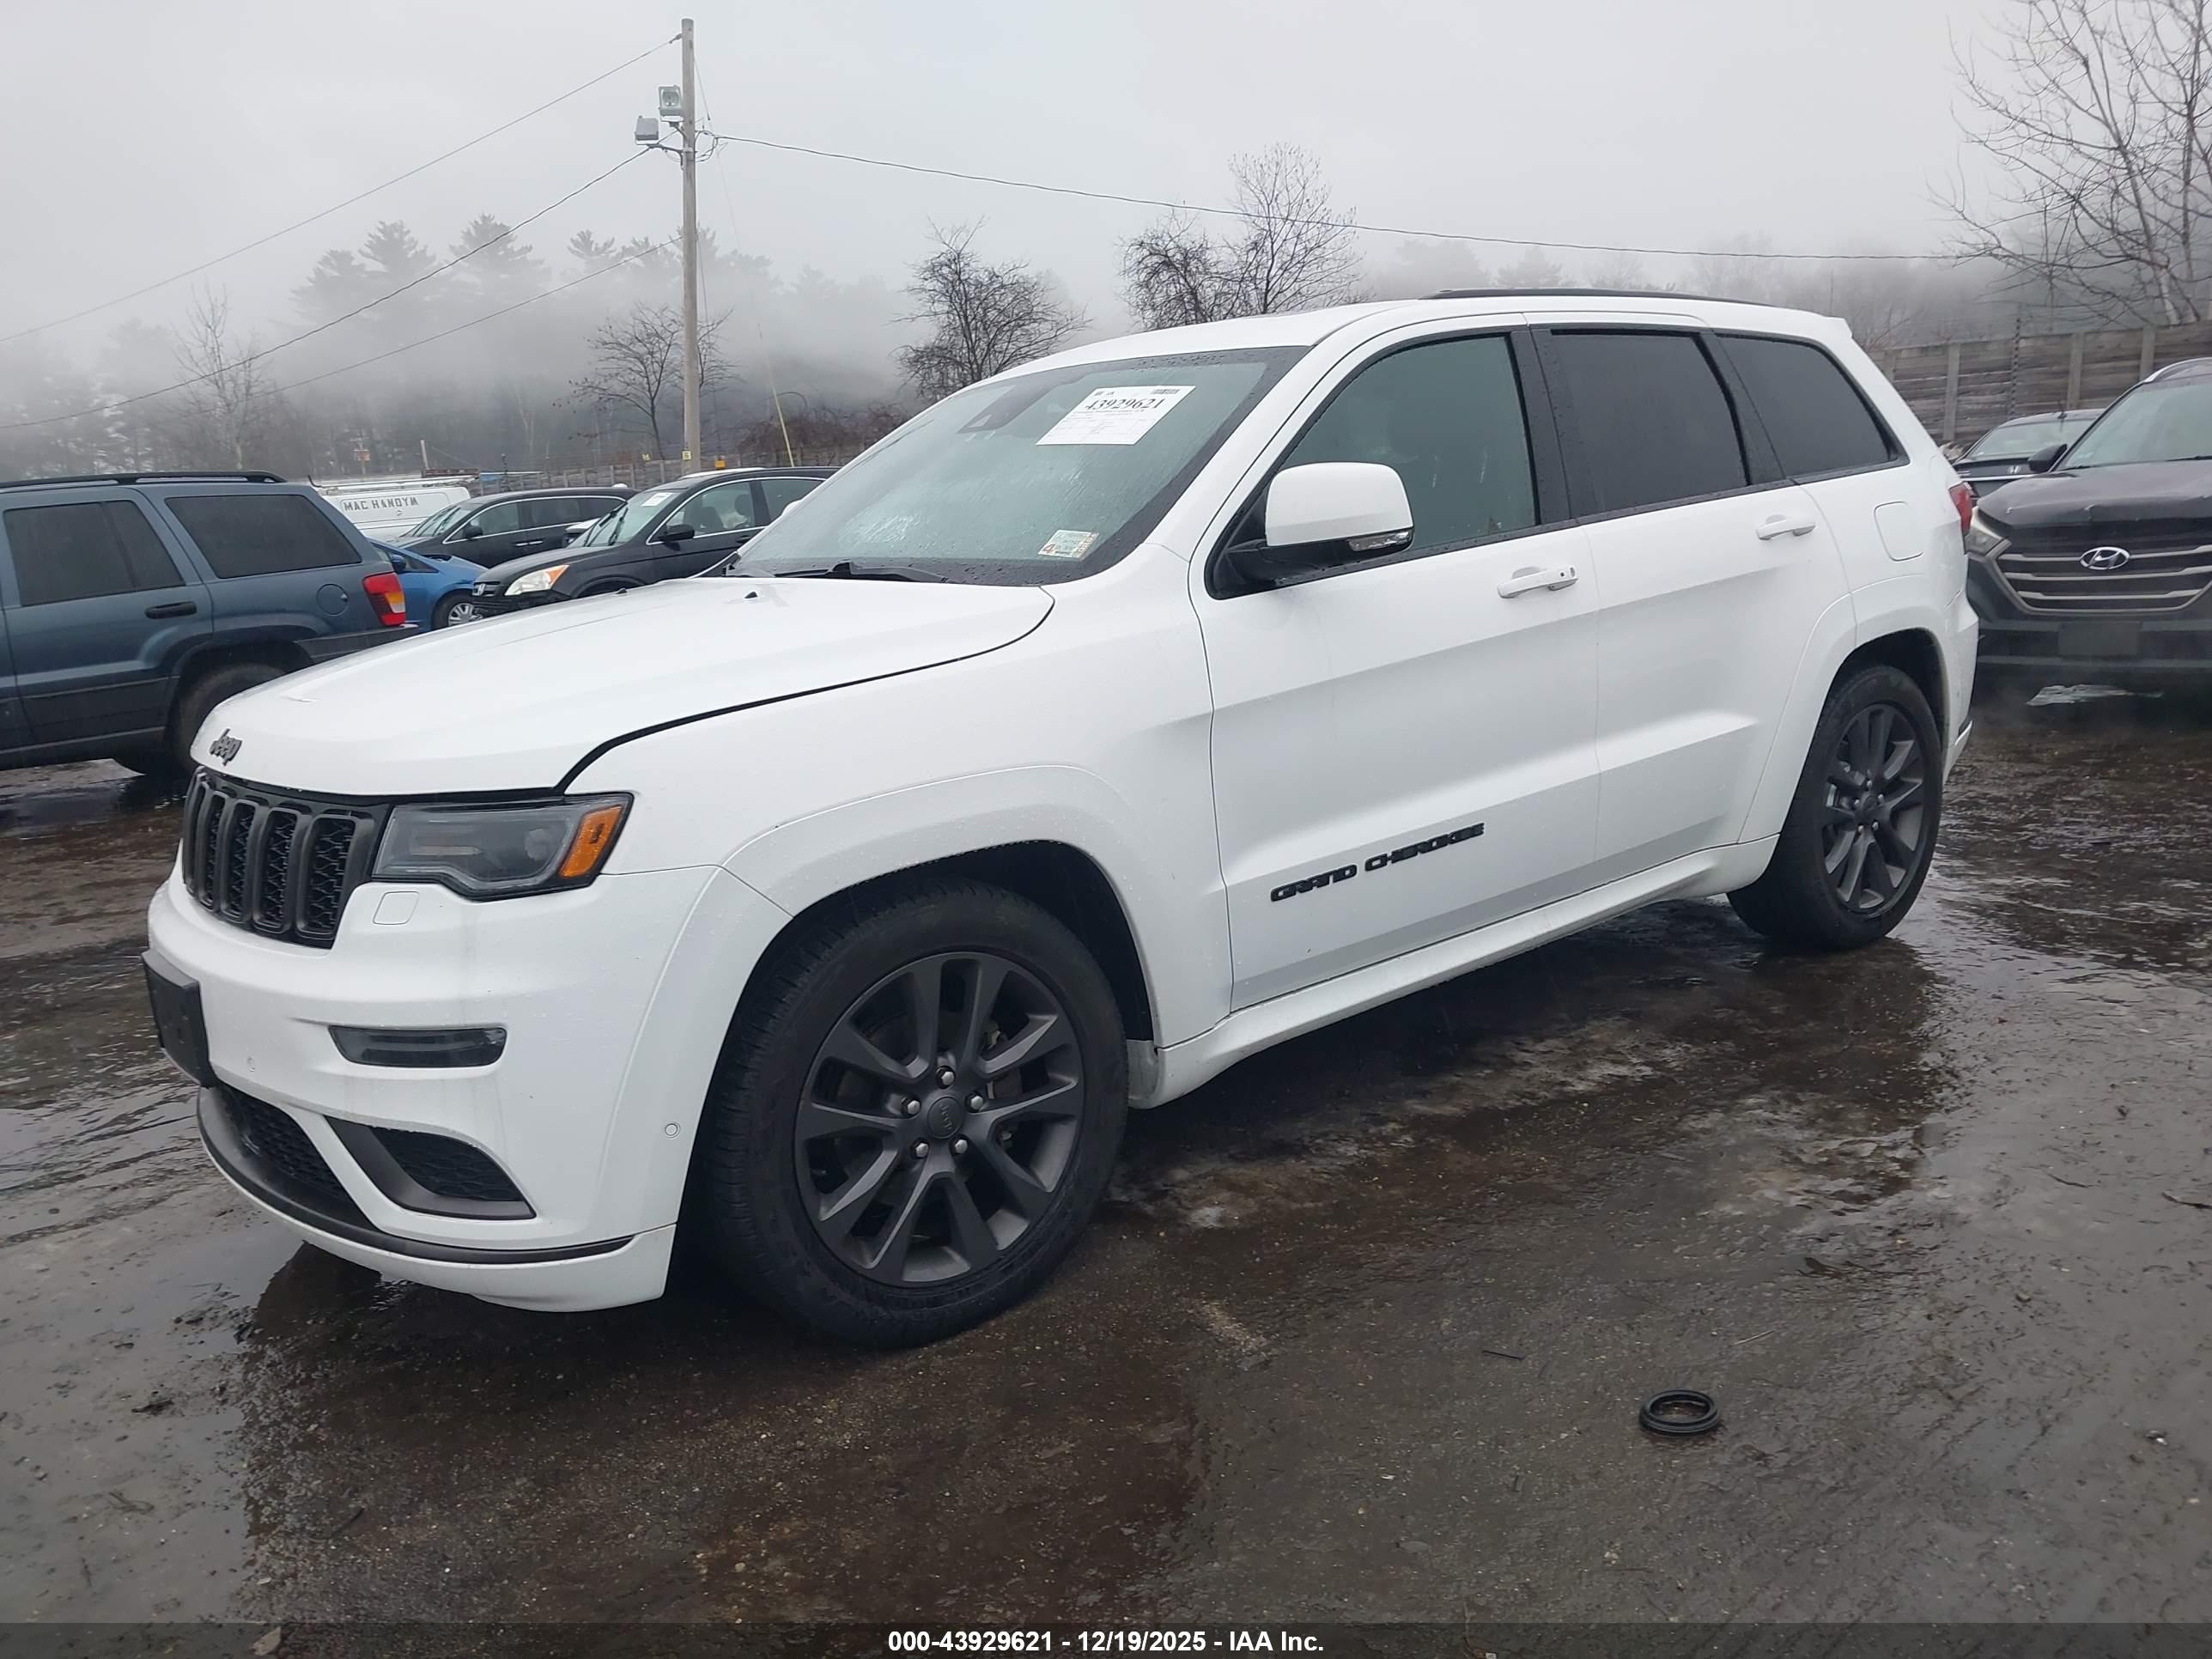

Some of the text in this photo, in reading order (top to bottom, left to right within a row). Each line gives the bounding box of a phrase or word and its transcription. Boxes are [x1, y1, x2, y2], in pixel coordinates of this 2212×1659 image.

[1085, 398, 1166, 410] 43929621
[343, 501, 368, 511] MAC
[209, 728, 242, 766] Jeep
[1271, 823, 1485, 902] GRAND CHEROKEE
